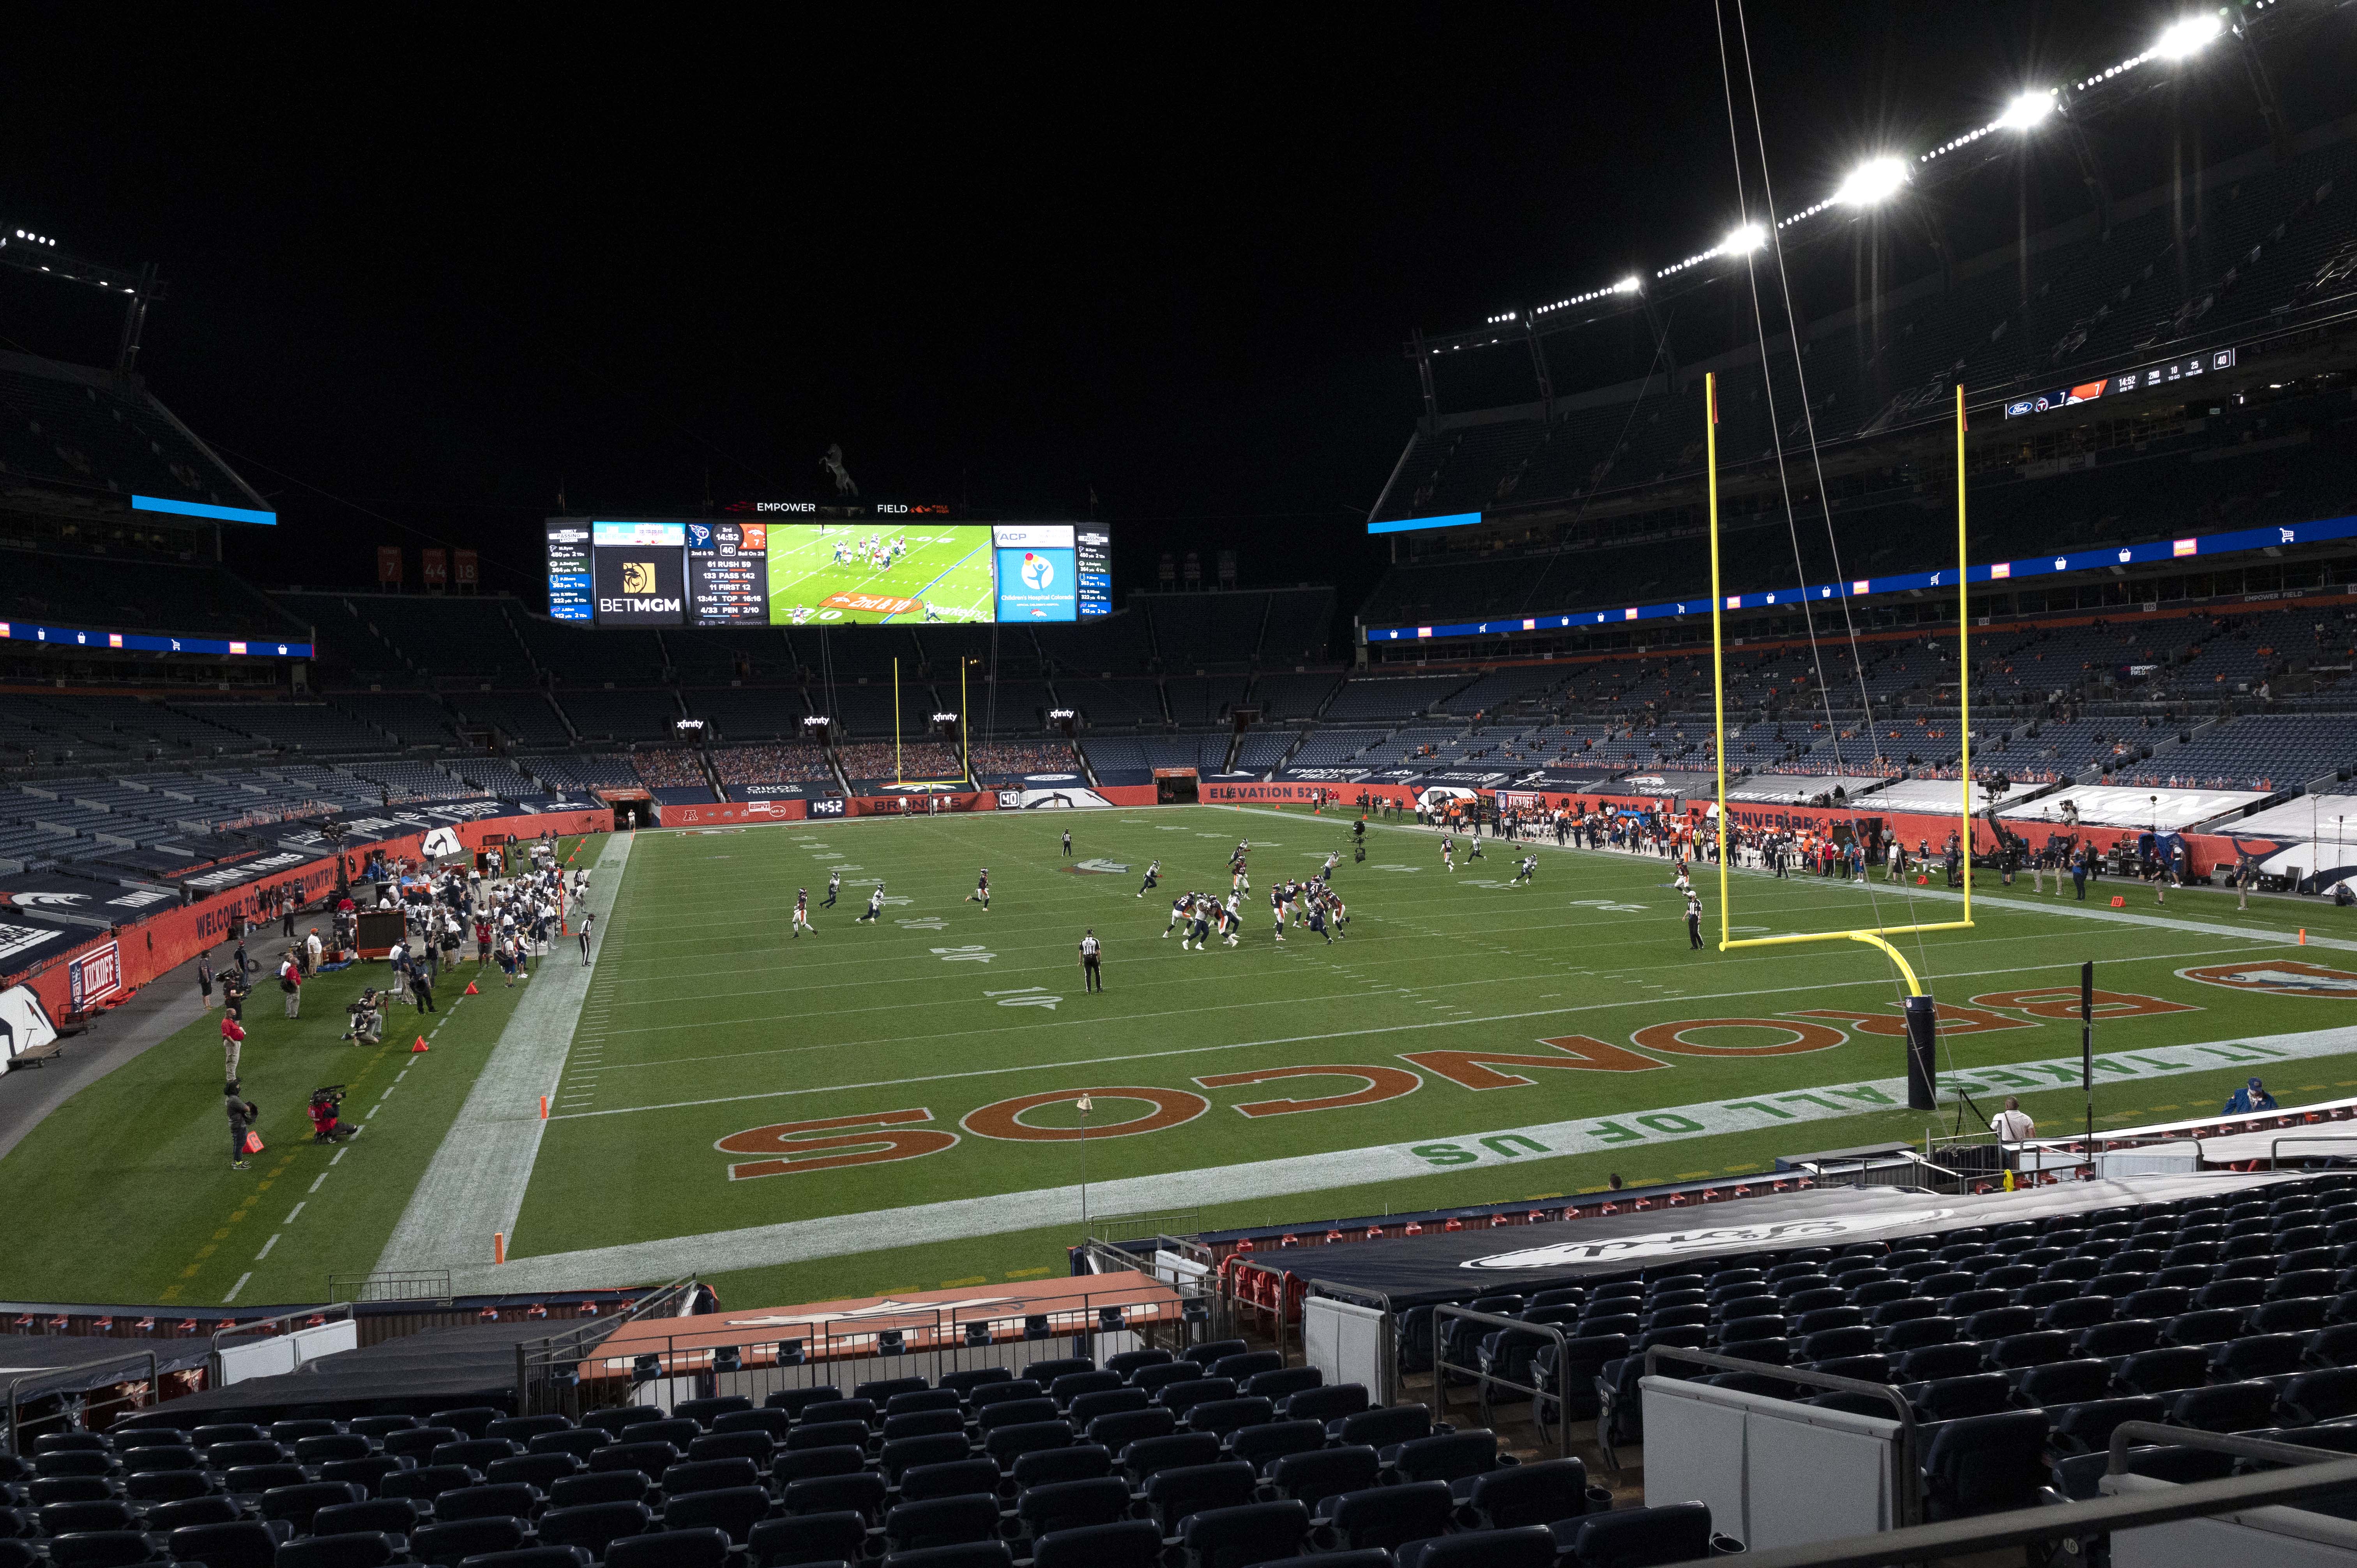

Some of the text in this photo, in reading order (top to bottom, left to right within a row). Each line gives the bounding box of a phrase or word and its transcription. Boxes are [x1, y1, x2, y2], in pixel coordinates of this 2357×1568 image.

[2191, 360, 2198, 370] 25
[2217, 355, 2226, 365] 40
[2149, 370, 2159, 380] 2ND
[2170, 366, 2178, 374] 10
[2118, 375, 2136, 387] 14:52
[2095, 383, 2100, 396] 7
[2060, 392, 2065, 403] 7
[2012, 404, 2028, 413] Ford
[757, 503, 908, 513] EMPOWER FIELD
[386, 562, 395, 576] 7
[424, 563, 446, 578] 44
[459, 565, 475, 579] 18
[848, 596, 912, 611] 2nd & 10
[2244, 593, 2278, 602] EMPOWER
[600, 598, 680, 612] BETMGM
[933, 713, 957, 722] xfinity
[1050, 710, 1074, 719] xfinity
[677, 720, 703, 729] xfinity
[804, 716, 829, 726] xfinity
[1002, 793, 1017, 804] 40
[1508, 795, 1533, 809] KICKOFF
[421, 801, 505, 812] EMPOWER
[814, 800, 842, 812] 14:52
[1310, 884, 1318, 892] 61
[106, 891, 170, 908] THANK
[894, 916, 950, 930] 30
[929, 945, 998, 963] 20
[84, 954, 113, 996] KICKOFF
[982, 986, 1064, 1010] 10
[714, 986, 2205, 1180] BRONCOS
[1412, 1042, 2288, 1166] IT TAKES ALL OF US
[250, 1133, 262, 1150] G
